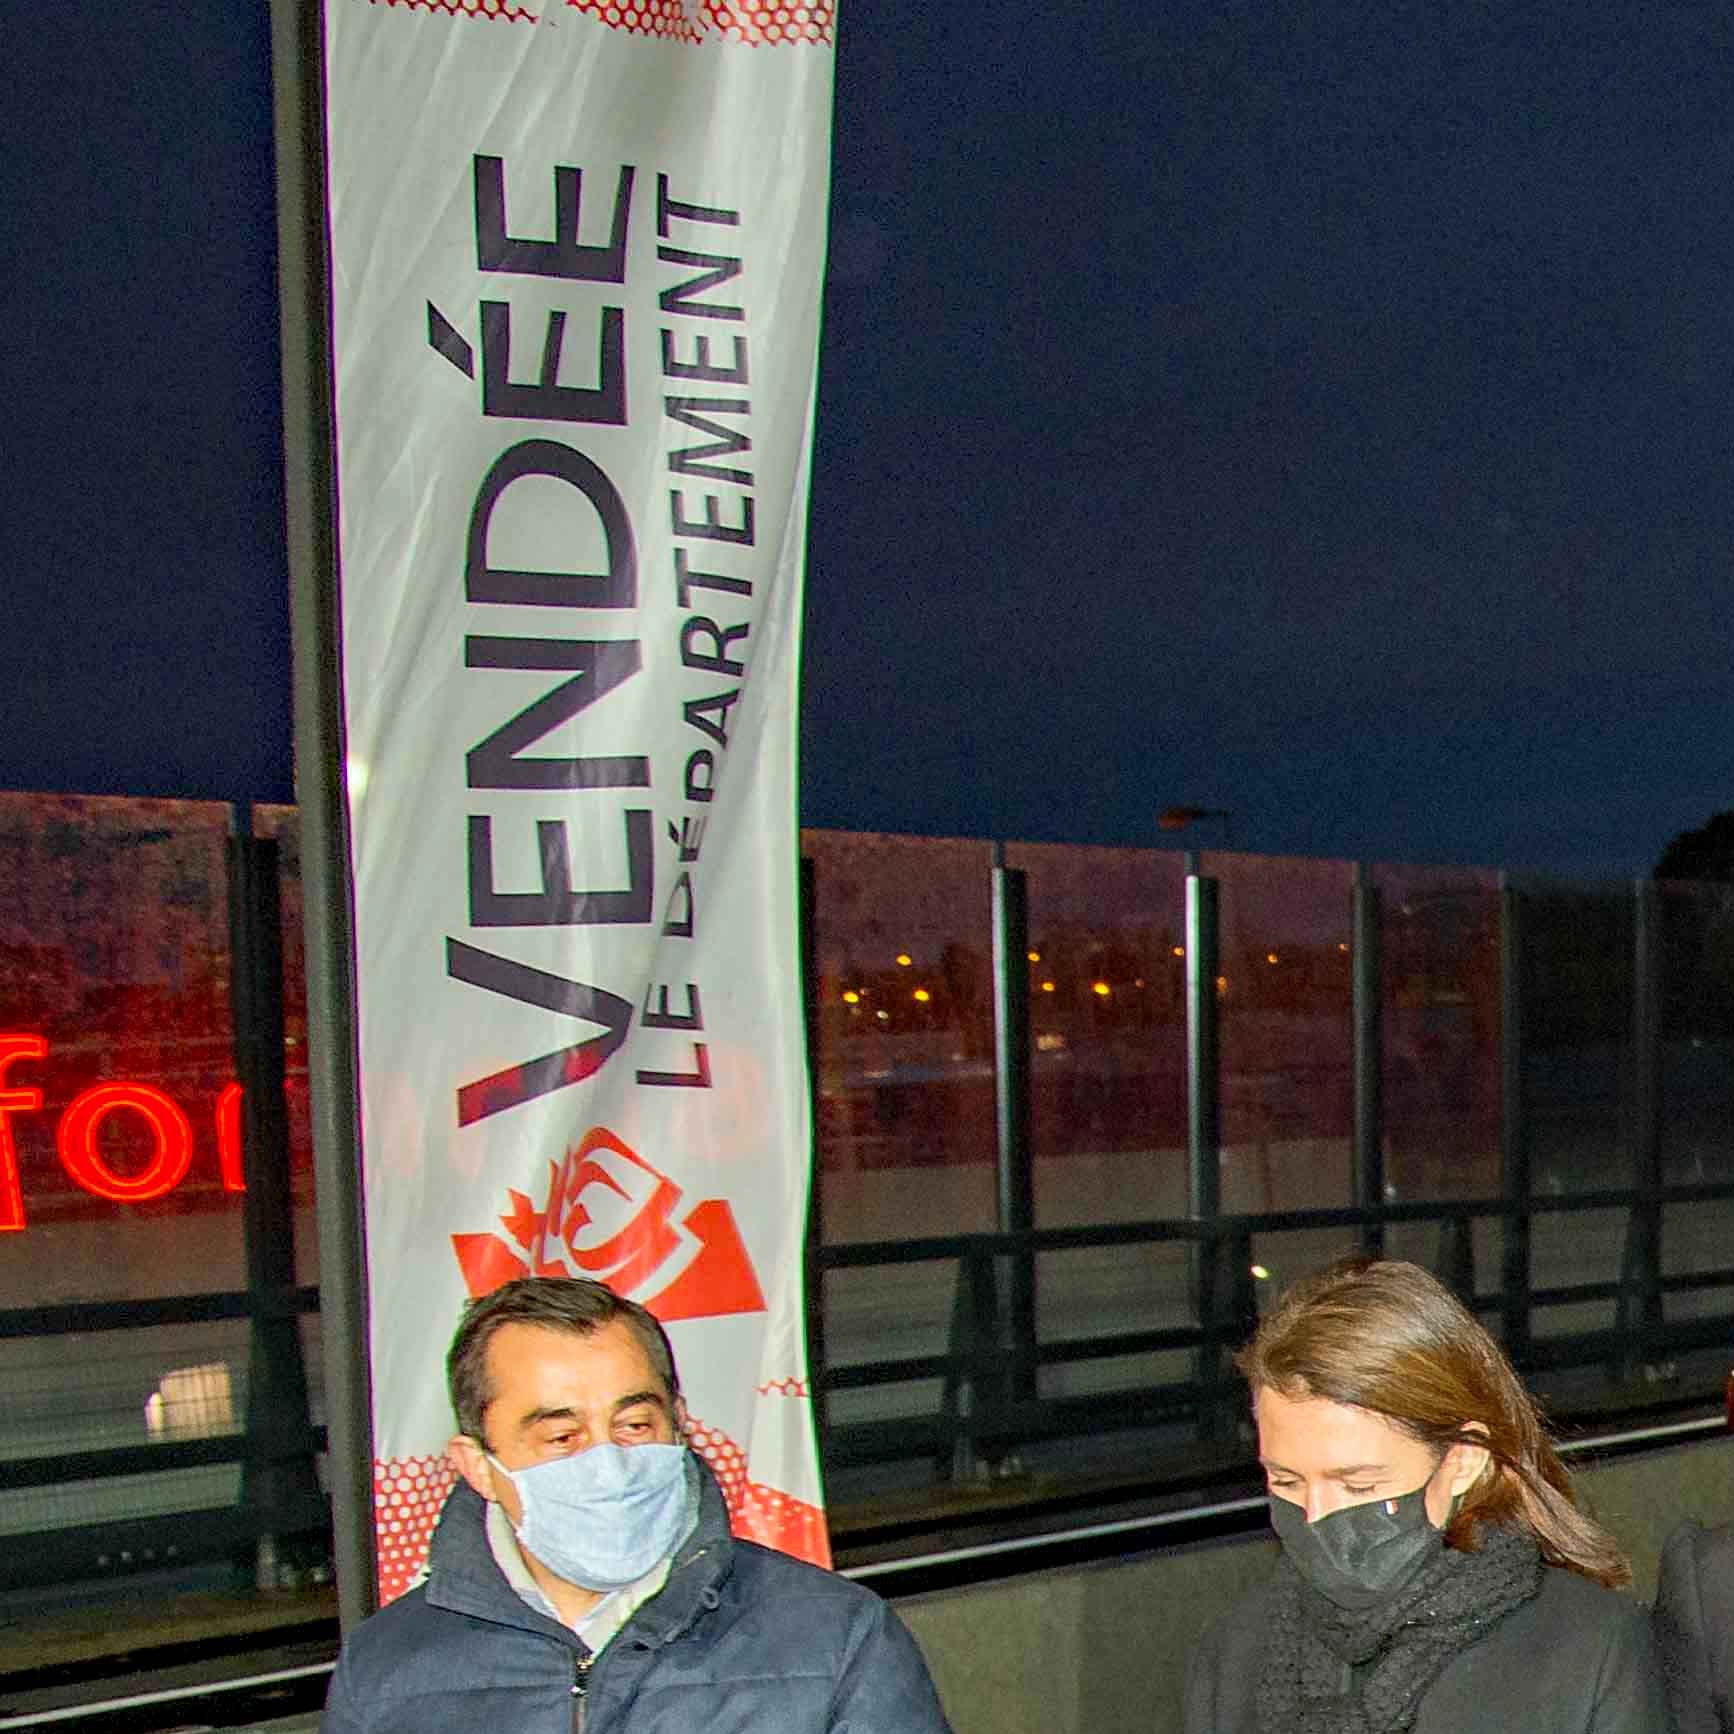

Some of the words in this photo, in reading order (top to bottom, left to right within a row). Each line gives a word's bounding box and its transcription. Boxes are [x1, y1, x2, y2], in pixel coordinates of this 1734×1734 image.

[426, 153, 654, 1127] VENDÉE
[656, 172, 756, 938] DÉPARTEMENT
[636, 983, 712, 1088] LE
